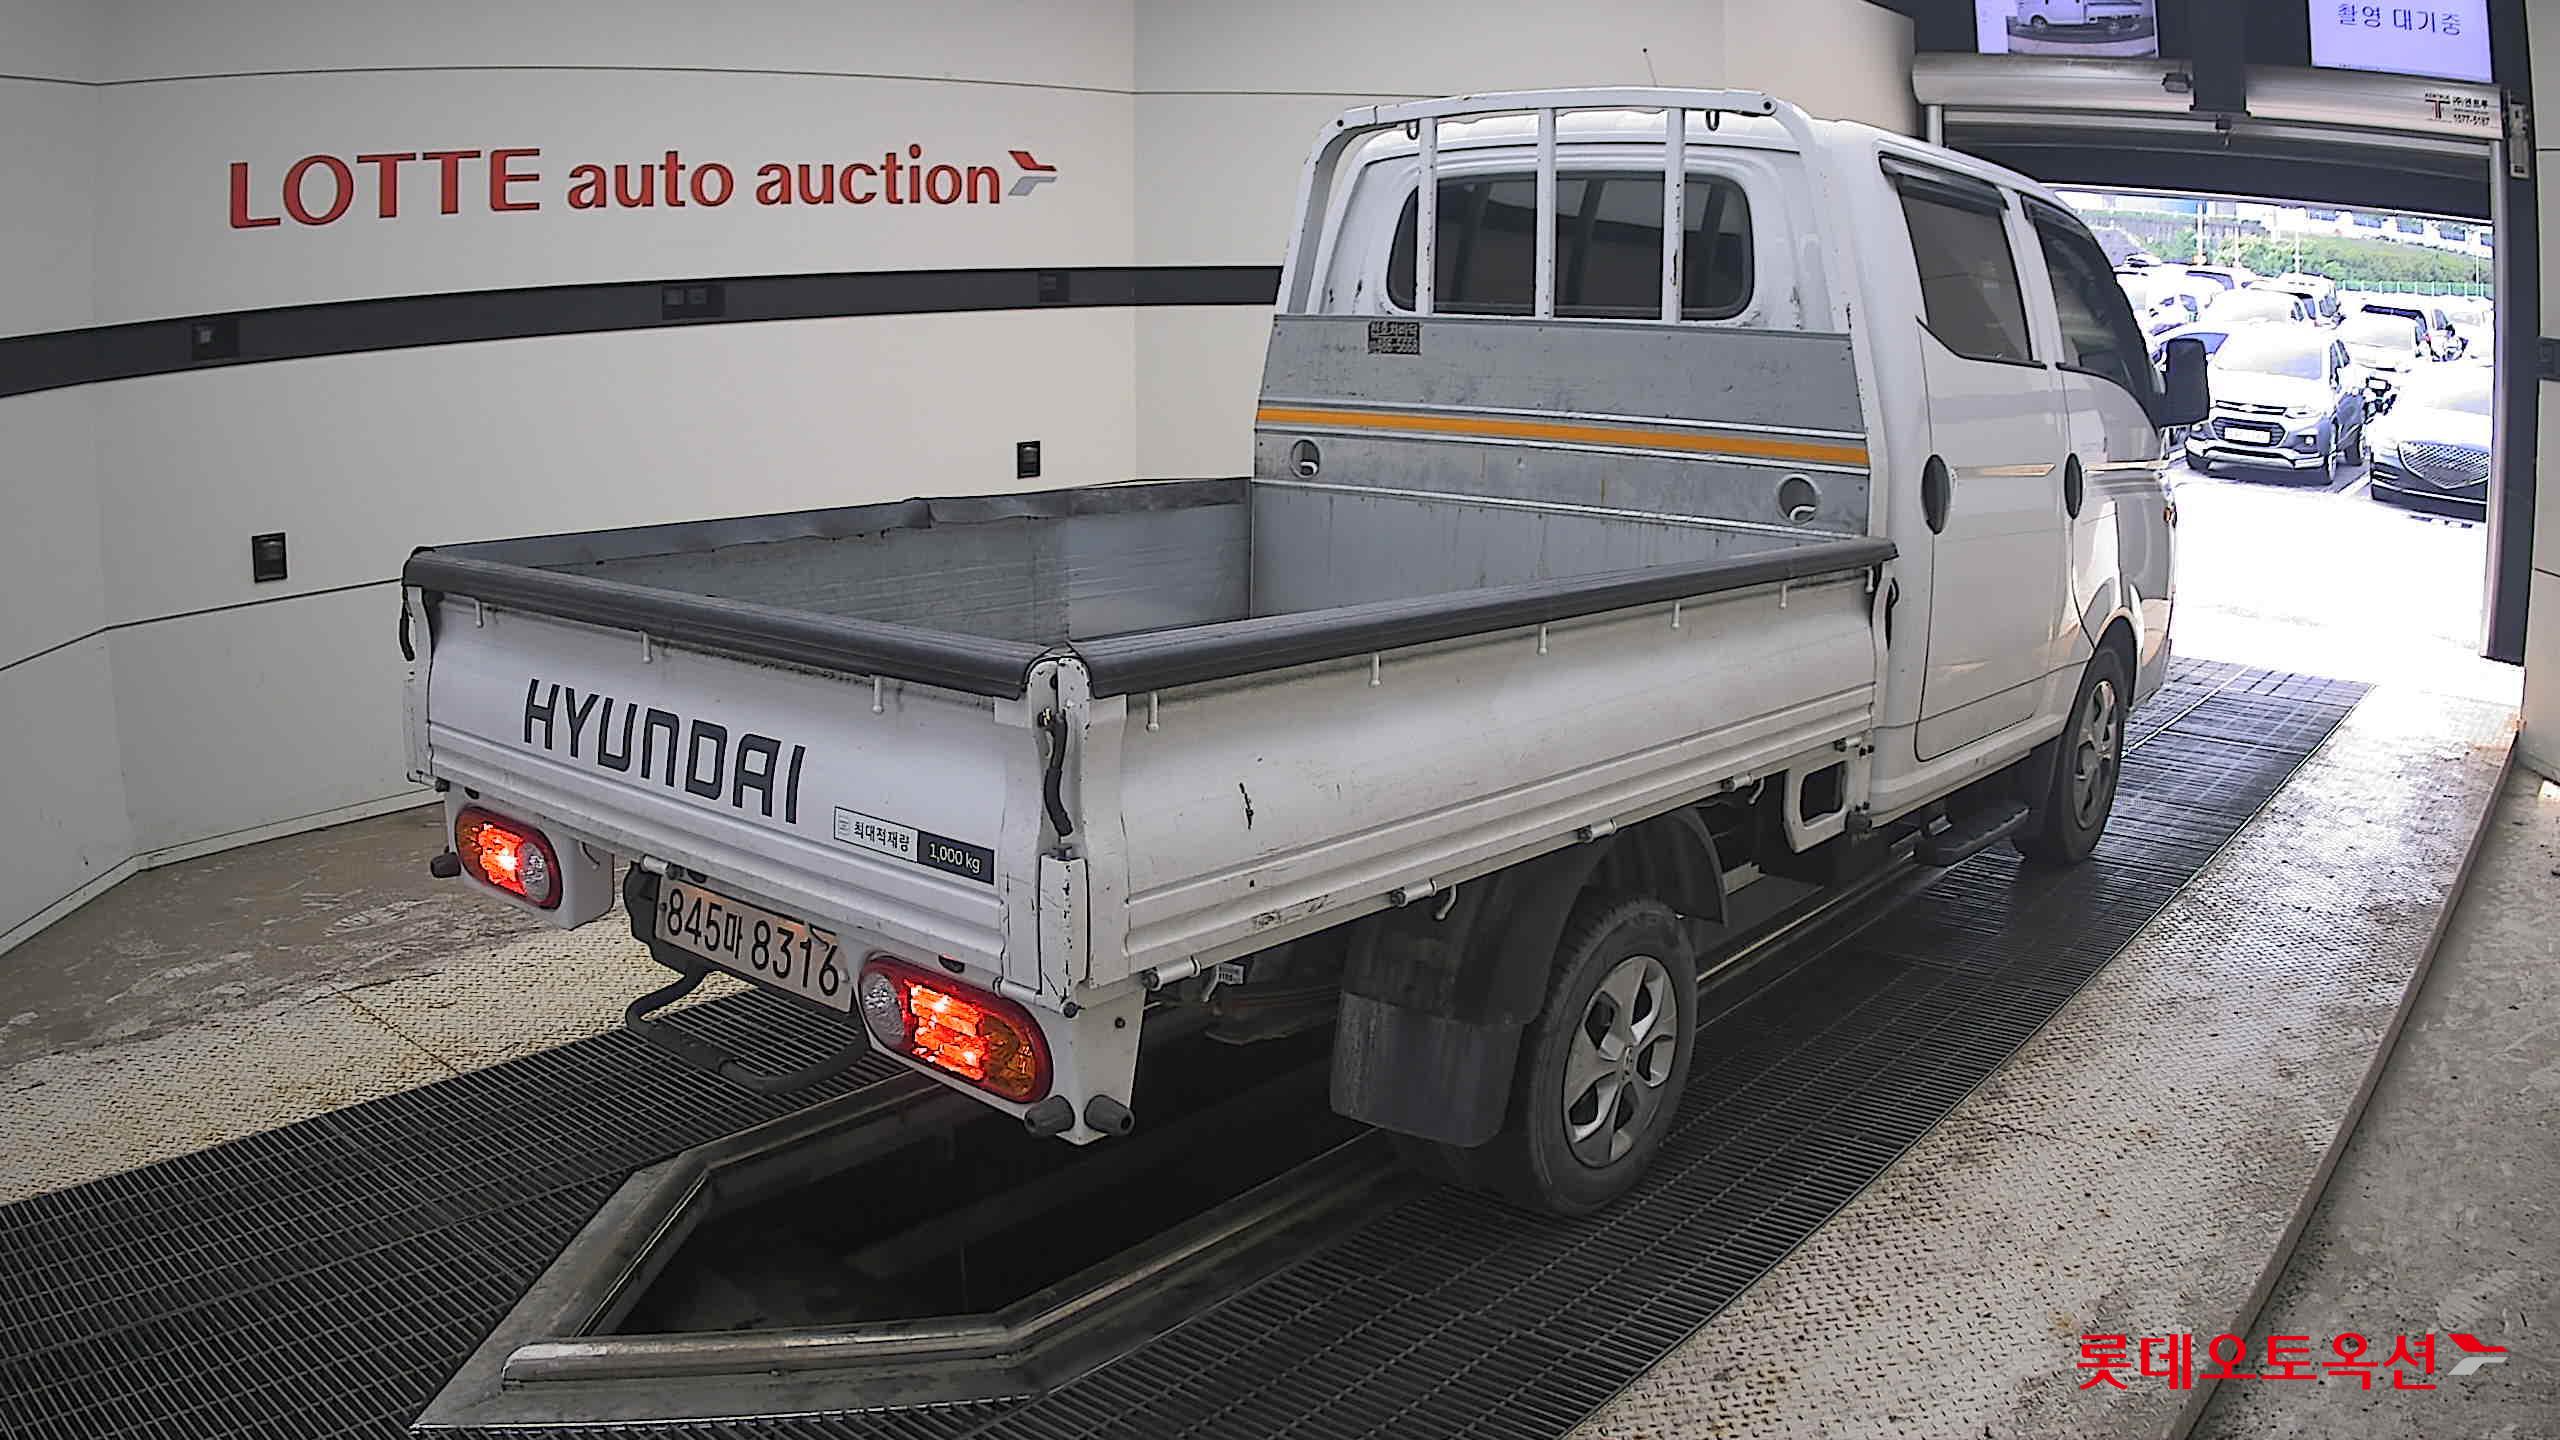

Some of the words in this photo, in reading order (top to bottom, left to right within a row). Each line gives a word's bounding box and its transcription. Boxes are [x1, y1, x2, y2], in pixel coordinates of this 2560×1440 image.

[2393, 8, 2461, 36] 대기중
[229, 148, 541, 229] LOTTE
[567, 149, 737, 209] auto
[755, 143, 1002, 206] auction
[524, 678, 806, 825] HYUNDAI
[854, 821, 910, 852] 최대적재량
[929, 843, 963, 866] 1,000
[965, 851, 981, 874] kg
[667, 888, 743, 959] 845마
[751, 920, 839, 996] 8316
